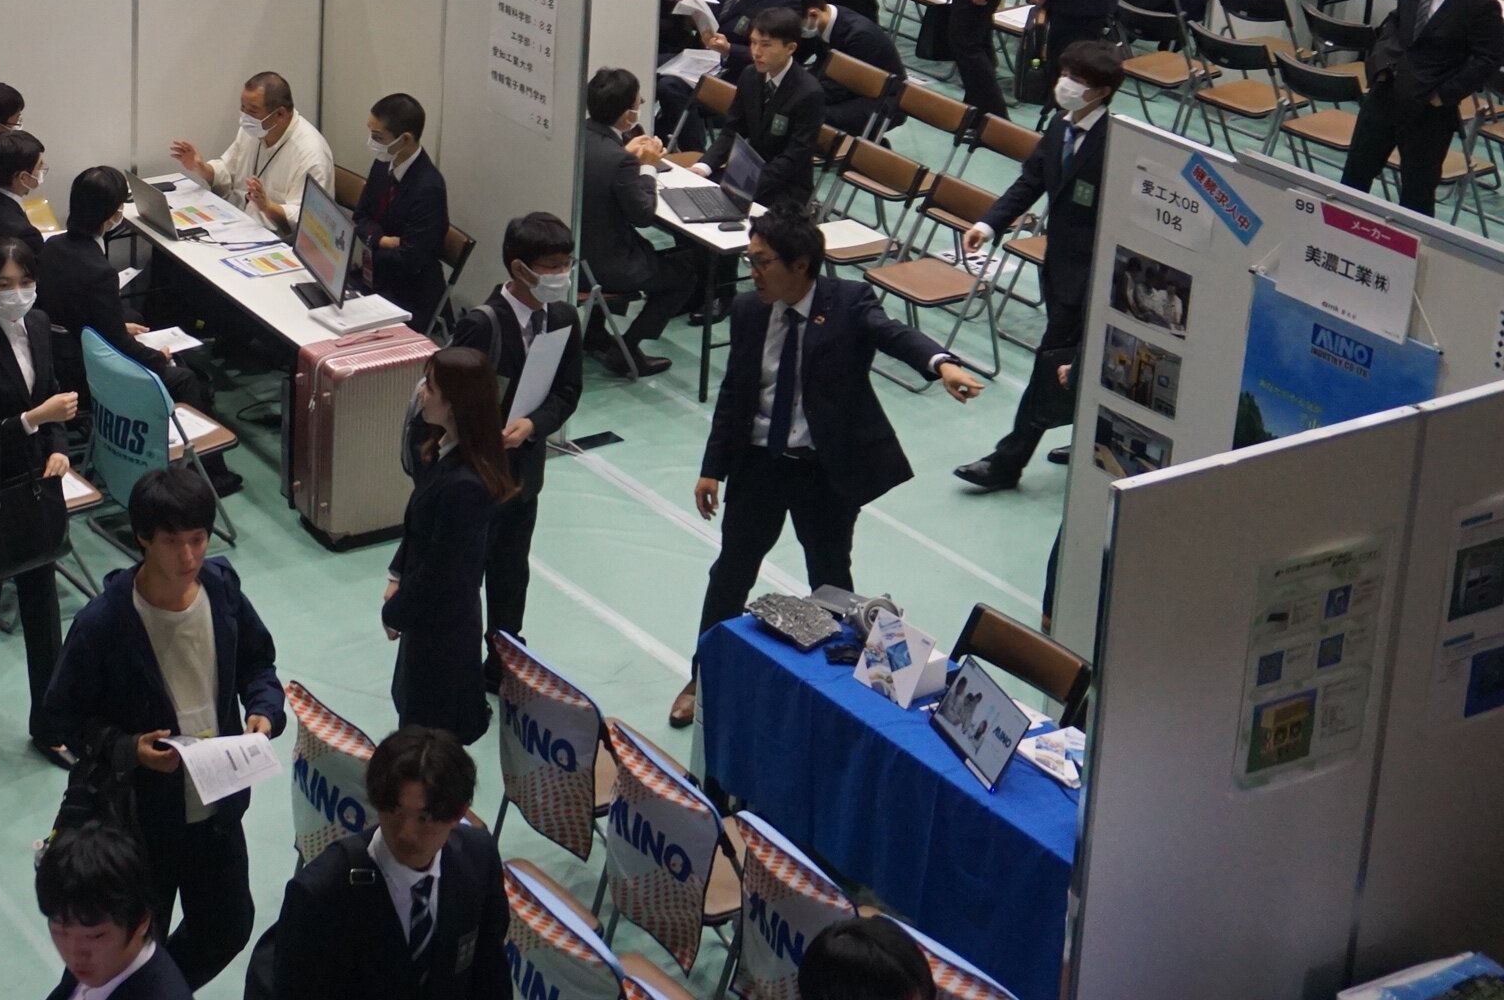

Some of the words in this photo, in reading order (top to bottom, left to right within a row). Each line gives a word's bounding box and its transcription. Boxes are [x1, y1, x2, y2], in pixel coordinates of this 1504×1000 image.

[491, 45, 534, 74] 愛知工業大学
[490, 69, 547, 106] 情報電子専門学校
[1140, 178, 1200, 215] 愛工大OB
[1154, 207, 1184, 233] 10名
[1191, 163, 1251, 232] 継続求人中
[1349, 219, 1391, 242] メーカー
[1313, 329, 1373, 367] MINO
[505, 703, 577, 773] MINO
[293, 757, 366, 833] MINO
[609, 795, 693, 883] MINO
[749, 891, 805, 970] MIN
[506, 939, 561, 1000] MIN
